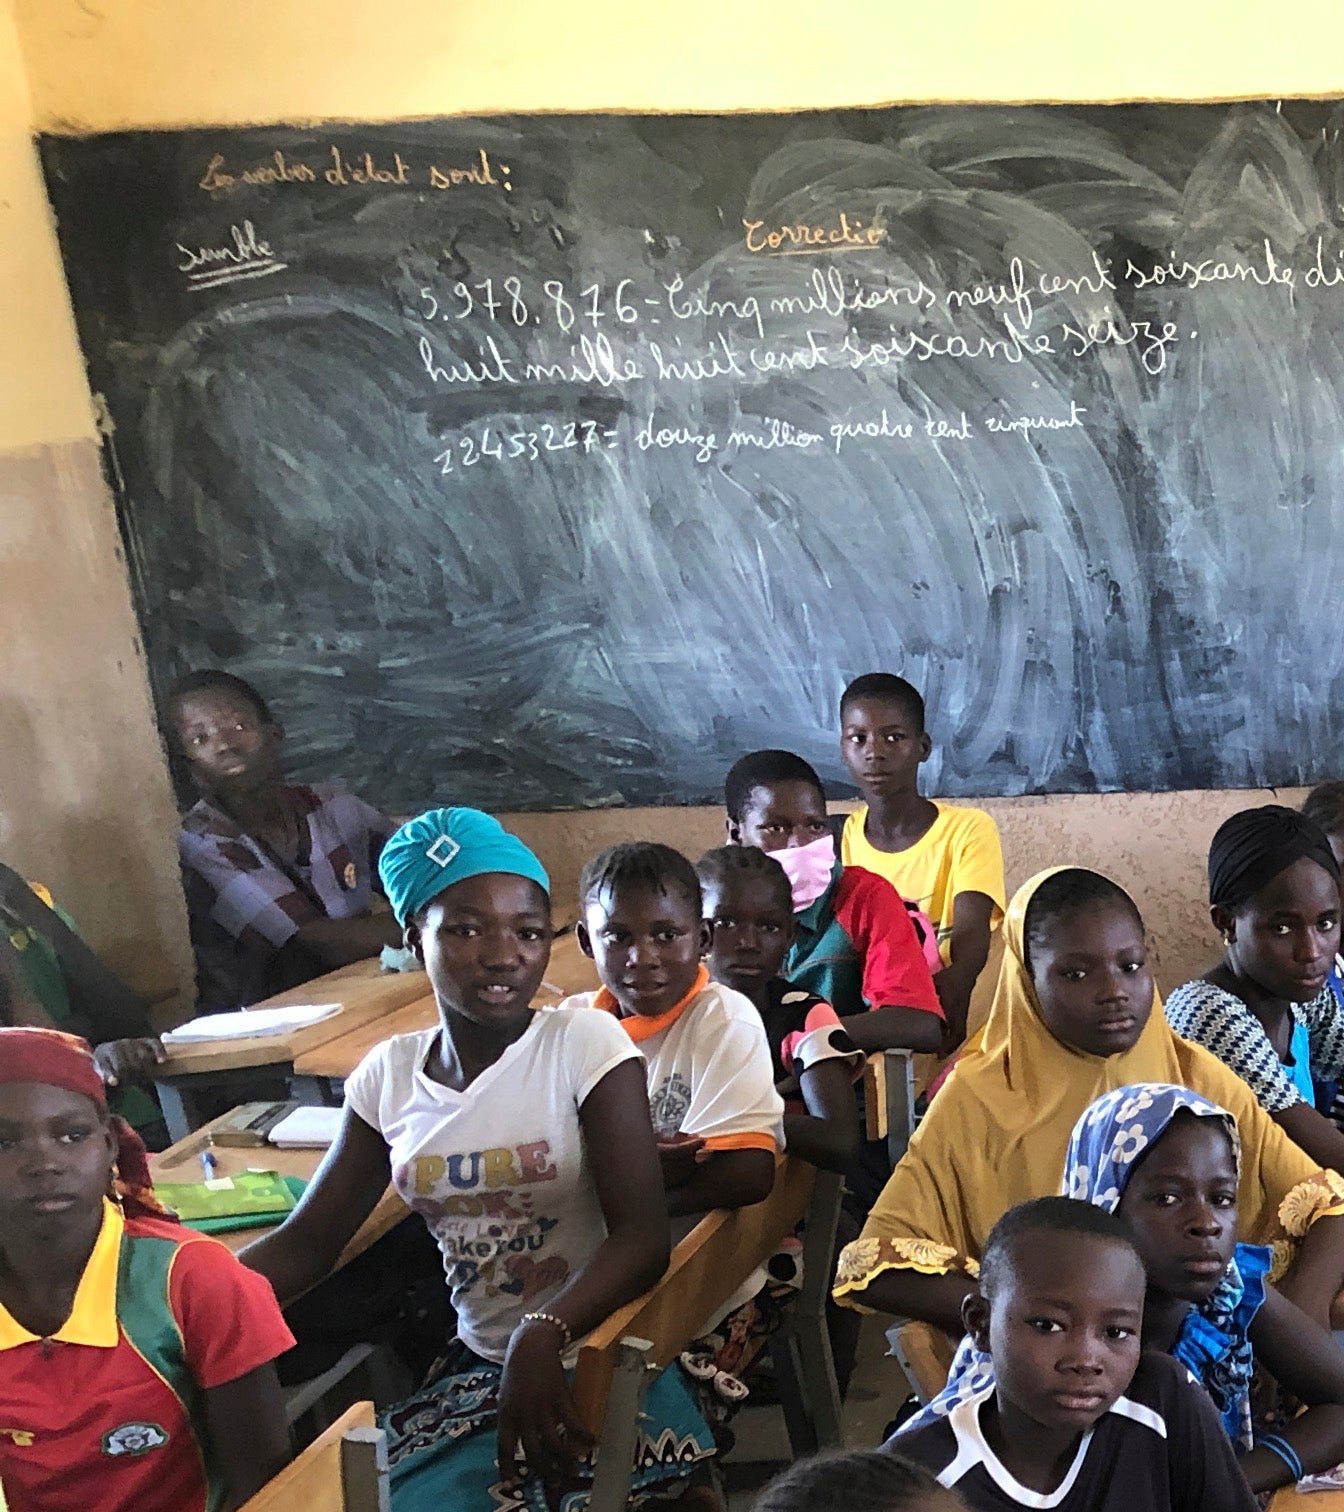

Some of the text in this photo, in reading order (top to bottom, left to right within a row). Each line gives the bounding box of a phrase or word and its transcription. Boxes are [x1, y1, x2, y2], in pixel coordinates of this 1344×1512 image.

[664, 273, 765, 338] Cinq
[771, 266, 936, 317] millions
[946, 257, 1033, 330] neuf
[1040, 250, 1116, 295] cent
[1126, 238, 1296, 288] soixante
[420, 335, 520, 383] huit
[526, 332, 645, 387] mille
[650, 331, 747, 381] huit
[750, 330, 829, 372] cent
[842, 313, 1056, 369] soixante
[638, 412, 718, 463] douze
[728, 417, 824, 451] million
[831, 410, 913, 454] quatre
[414, 1140, 558, 1196] PURE
